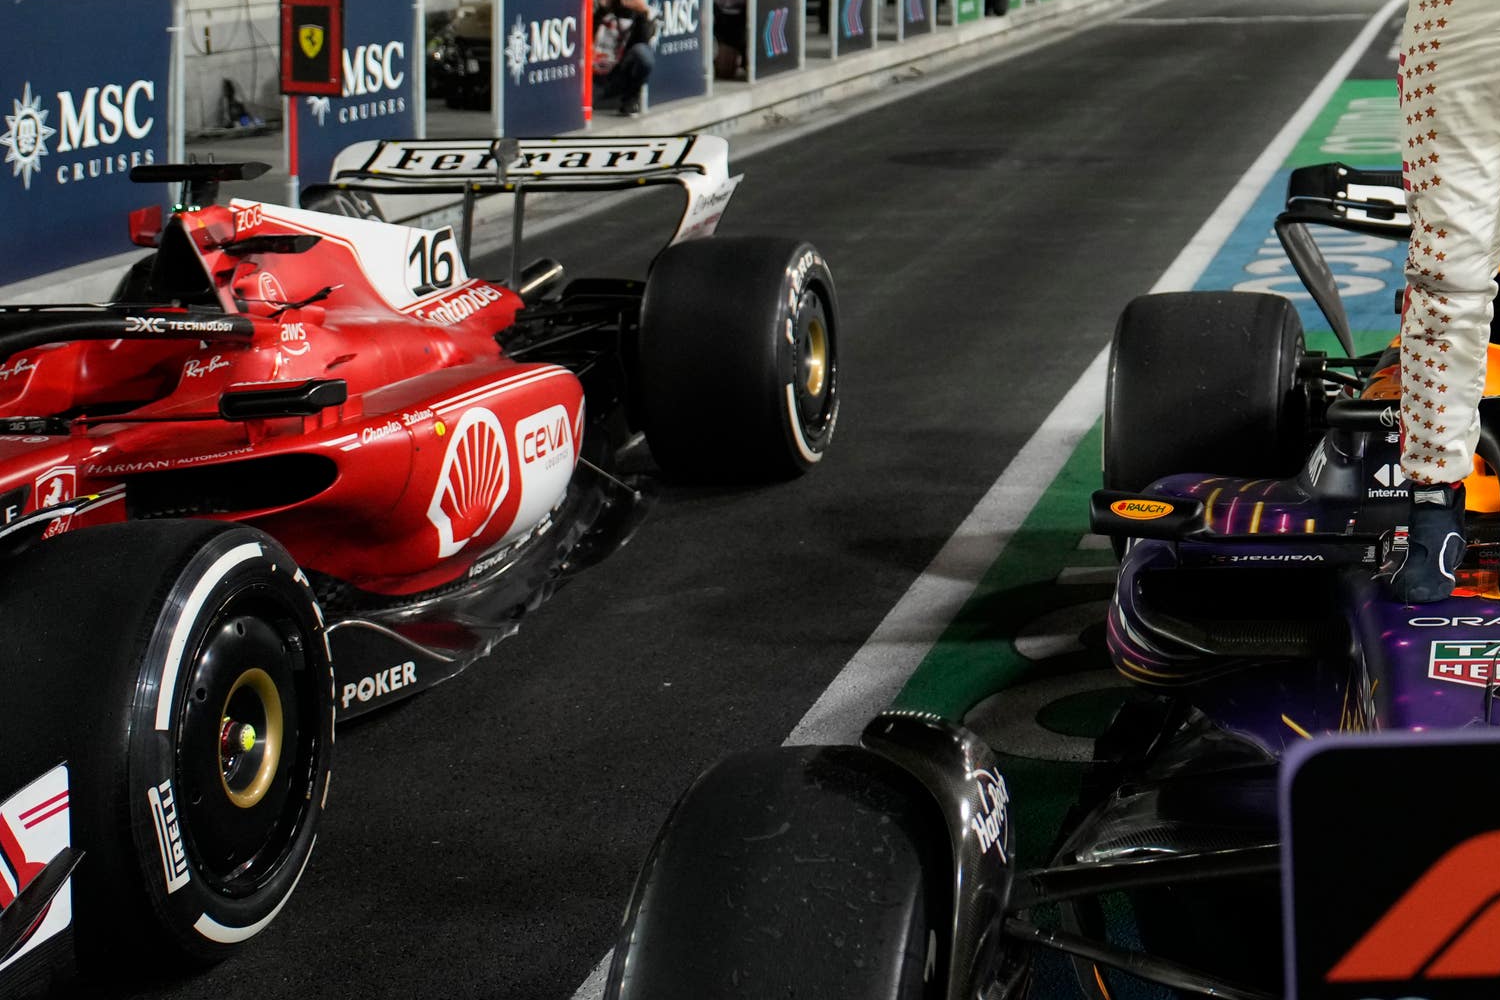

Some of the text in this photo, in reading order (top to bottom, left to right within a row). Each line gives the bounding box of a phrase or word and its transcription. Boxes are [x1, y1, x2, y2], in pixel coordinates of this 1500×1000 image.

[531, 16, 577, 63] MSC
[343, 41, 405, 97] MSC
[528, 63, 576, 85] CRUISES
[57, 80, 155, 153] MSC
[339, 97, 405, 124] CRUISES
[57, 149, 155, 184] CRUISES
[409, 229, 454, 298] 16
[125, 317, 234, 333] DXC TECHNOLOGY
[280, 322, 306, 342] aws
[184, 355, 232, 378] Ray-Ban
[362, 408, 434, 444] Charles Leclerc
[87, 445, 255, 475] HARMAN AUTOMOTIVE
[1126, 502, 1167, 514] RAUCH
[1368, 488, 1409, 498] inter.m
[1231, 553, 1325, 562] Walmart
[342, 660, 418, 711] POKER
[147, 778, 191, 895] PIRELLI
